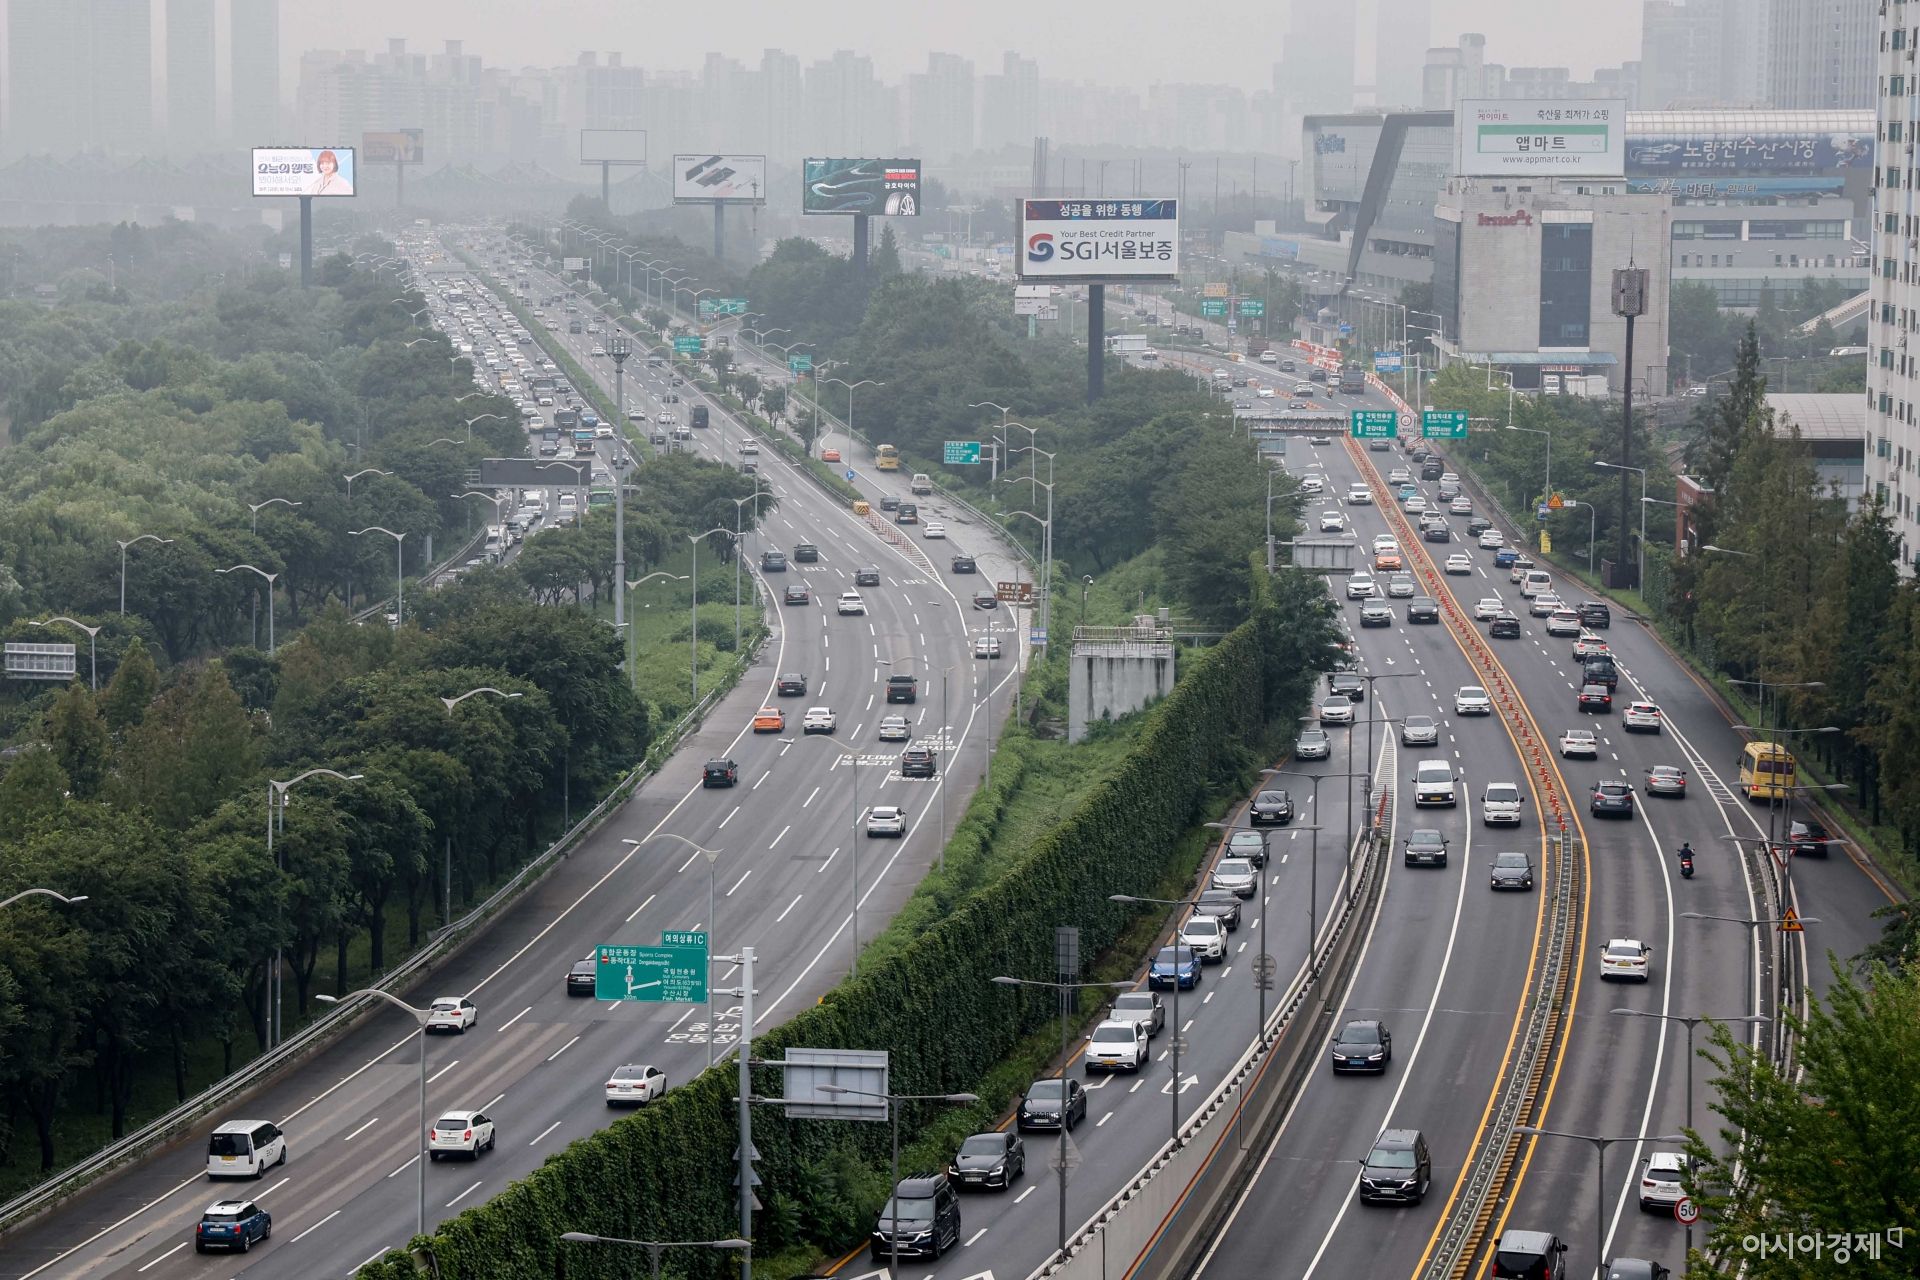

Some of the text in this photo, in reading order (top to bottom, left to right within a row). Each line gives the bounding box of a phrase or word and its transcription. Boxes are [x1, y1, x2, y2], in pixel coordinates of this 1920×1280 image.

[1537, 109, 1609, 121] 축산물 최저가 쇼핑
[1516, 136, 1567, 151] 앱마트
[1682, 136, 1818, 162] 노량진수산시장
[1502, 155, 1581, 164] www.appmart.co.kr
[258, 163, 290, 174] 오늘의
[884, 182, 916, 190] 금호타이어
[1686, 183, 1716, 198] 바다
[1059, 204, 1142, 217] 성공을 위한 동행
[1060, 230, 1156, 238] Your Best Credit Partner
[1060, 240, 1173, 261] SGI서울보증
[665, 933, 704, 945] 여의상류IC
[601, 948, 637, 957] 종합운동장
[610, 957, 637, 965] 동작대교
[662, 968, 696, 976] 국립현충원
[1680, 1204, 1696, 1217] 50
